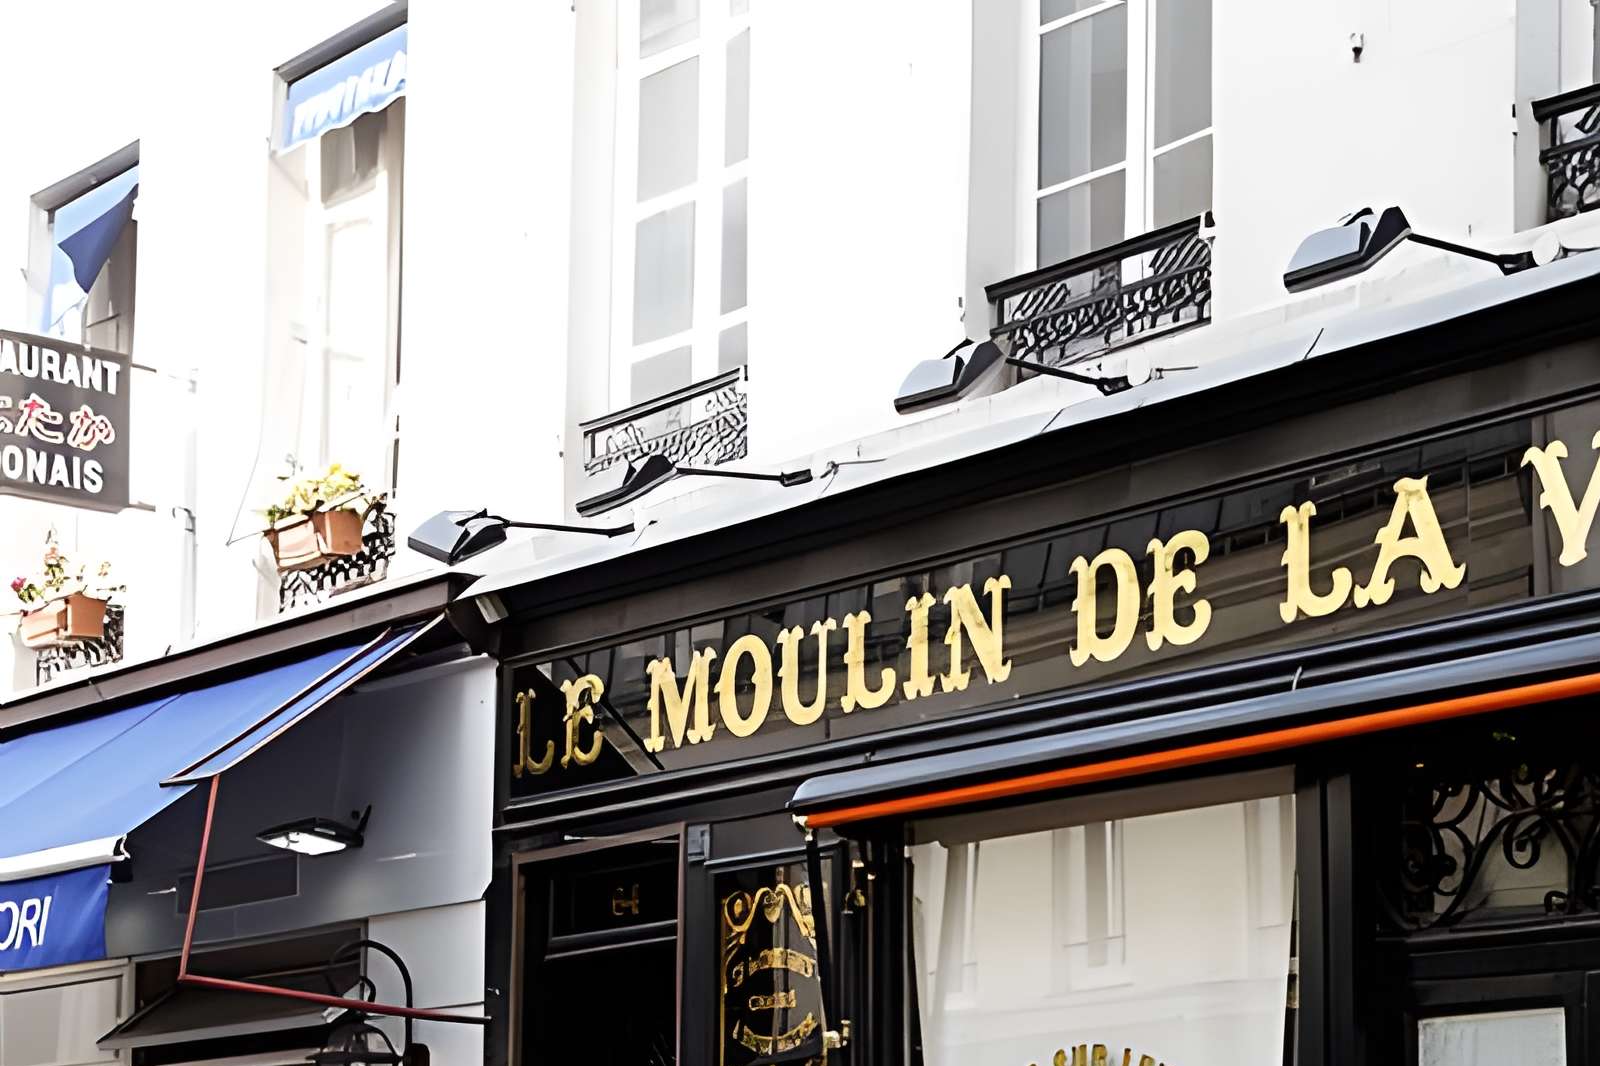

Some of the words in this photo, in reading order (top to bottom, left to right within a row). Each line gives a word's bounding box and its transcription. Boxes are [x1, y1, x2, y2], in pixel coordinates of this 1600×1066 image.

[0, 338, 121, 395] AURANT
[0, 445, 104, 494] ONAIS
[514, 672, 605, 778] LE
[644, 574, 1012, 753] MOULIN
[1069, 529, 1213, 668] DE
[1279, 475, 1467, 624] LA
